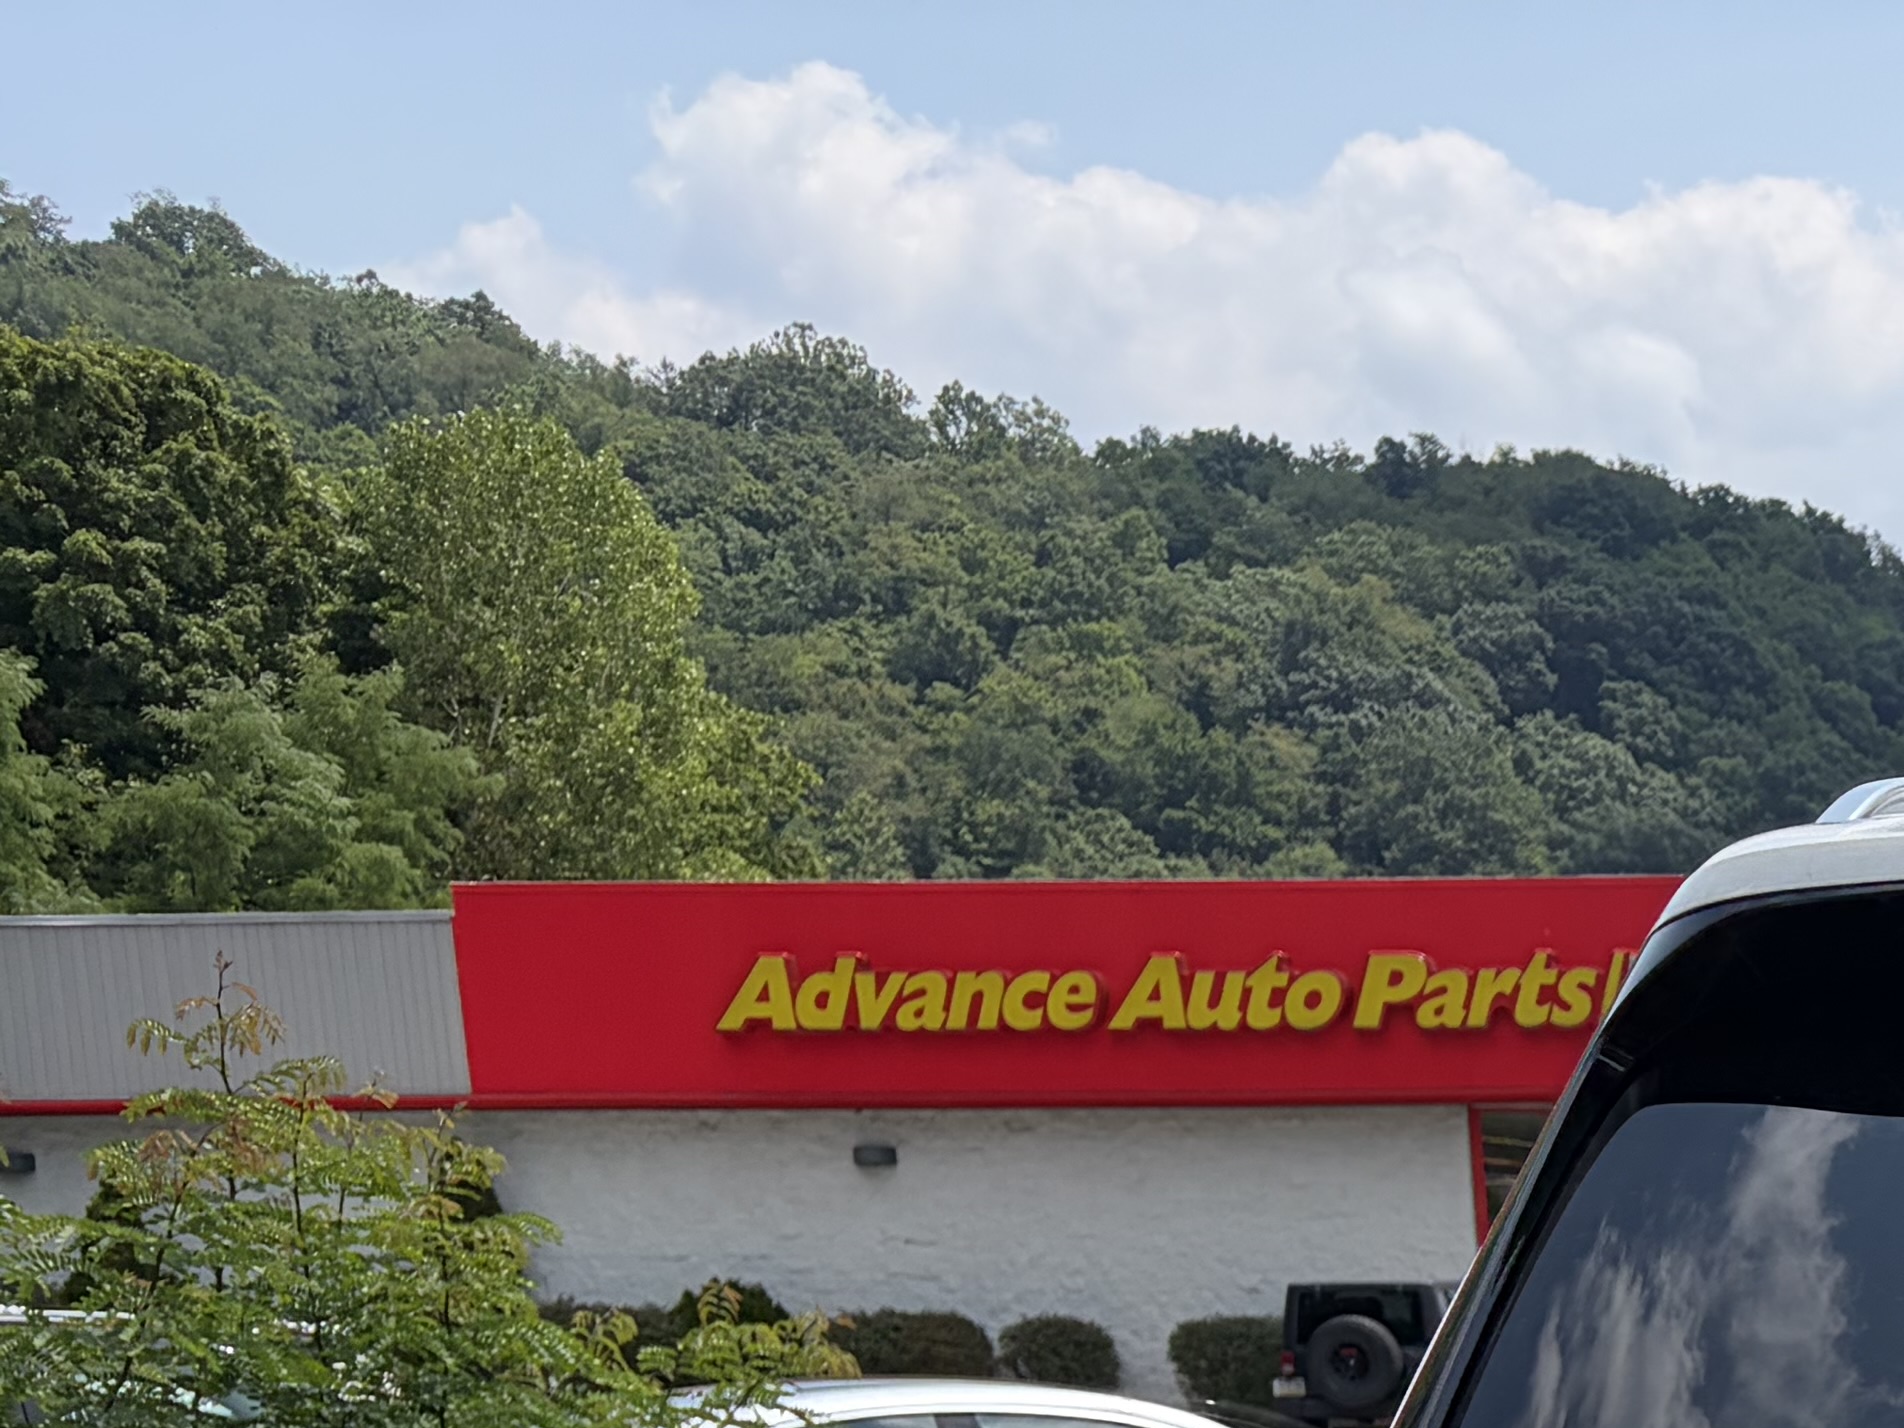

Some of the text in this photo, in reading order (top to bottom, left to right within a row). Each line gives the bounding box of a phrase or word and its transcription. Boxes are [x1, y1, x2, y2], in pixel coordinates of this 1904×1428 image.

[716, 951, 1598, 1033] Advance Auto Parts
